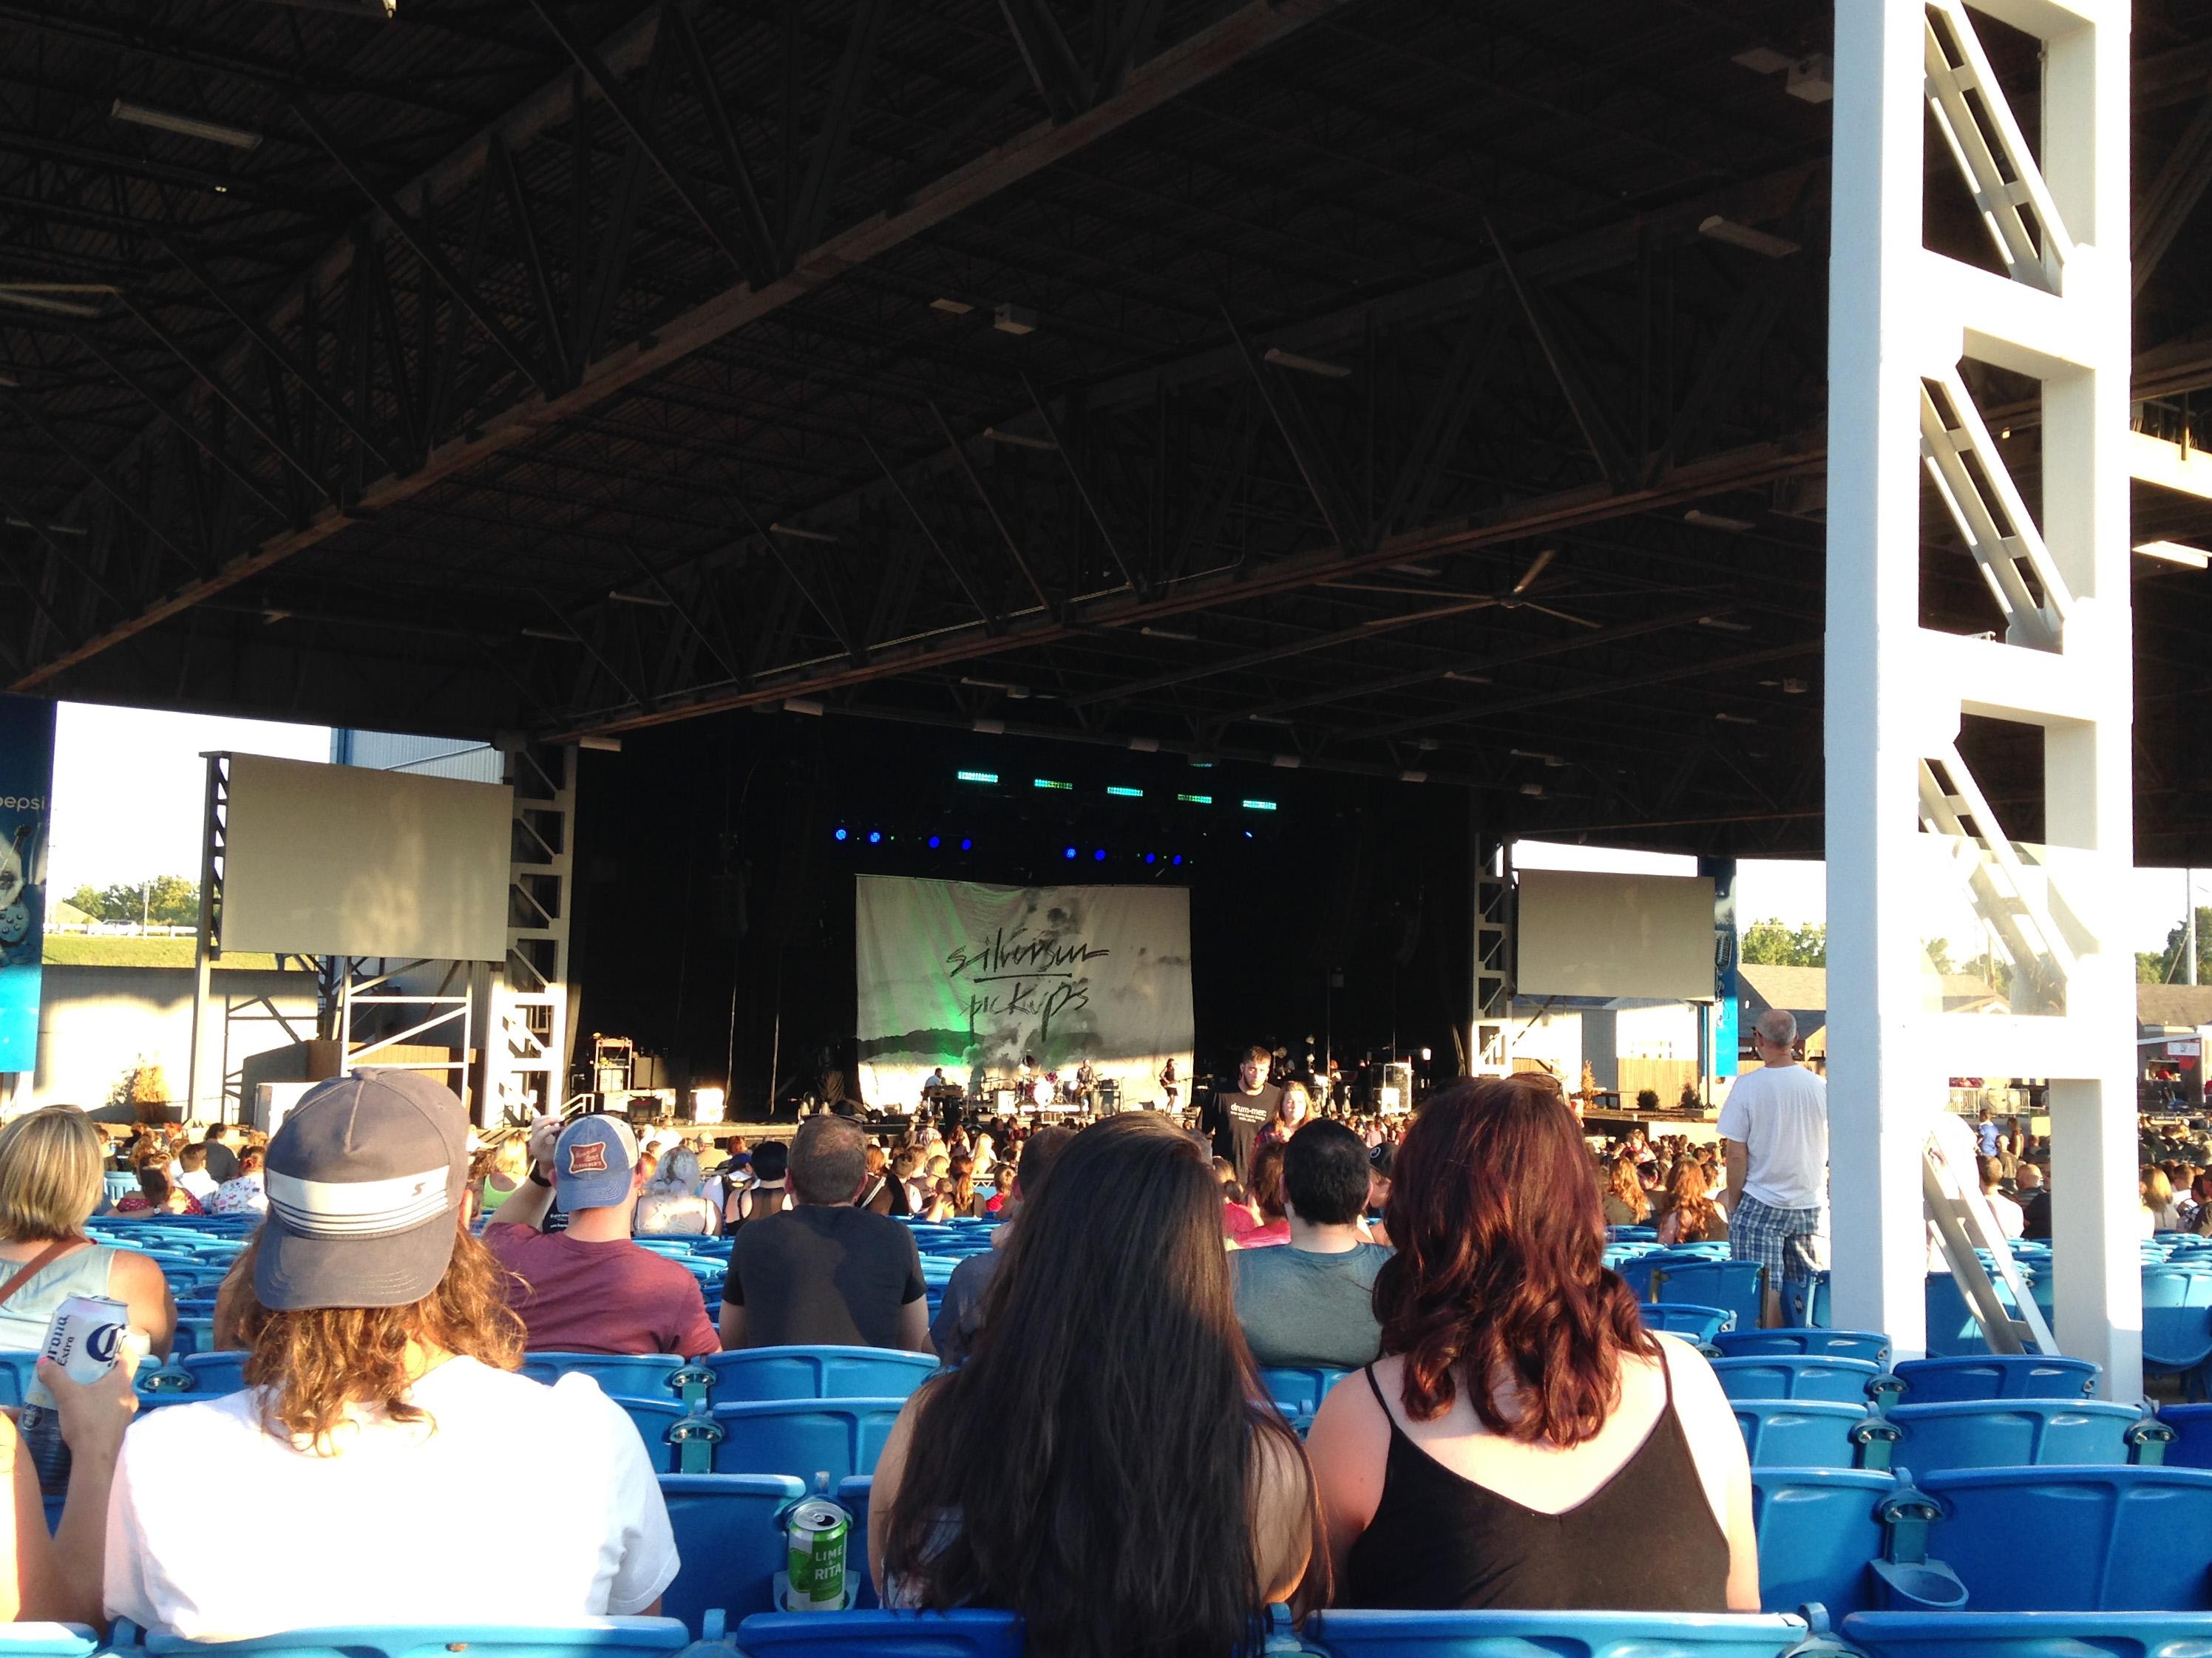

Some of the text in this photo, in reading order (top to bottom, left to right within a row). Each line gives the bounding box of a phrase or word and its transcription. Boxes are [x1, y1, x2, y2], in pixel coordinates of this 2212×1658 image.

[0, 795, 45, 812] epsi
[815, 1545, 843, 1562] LIME
[815, 1563, 842, 1580] RITA
